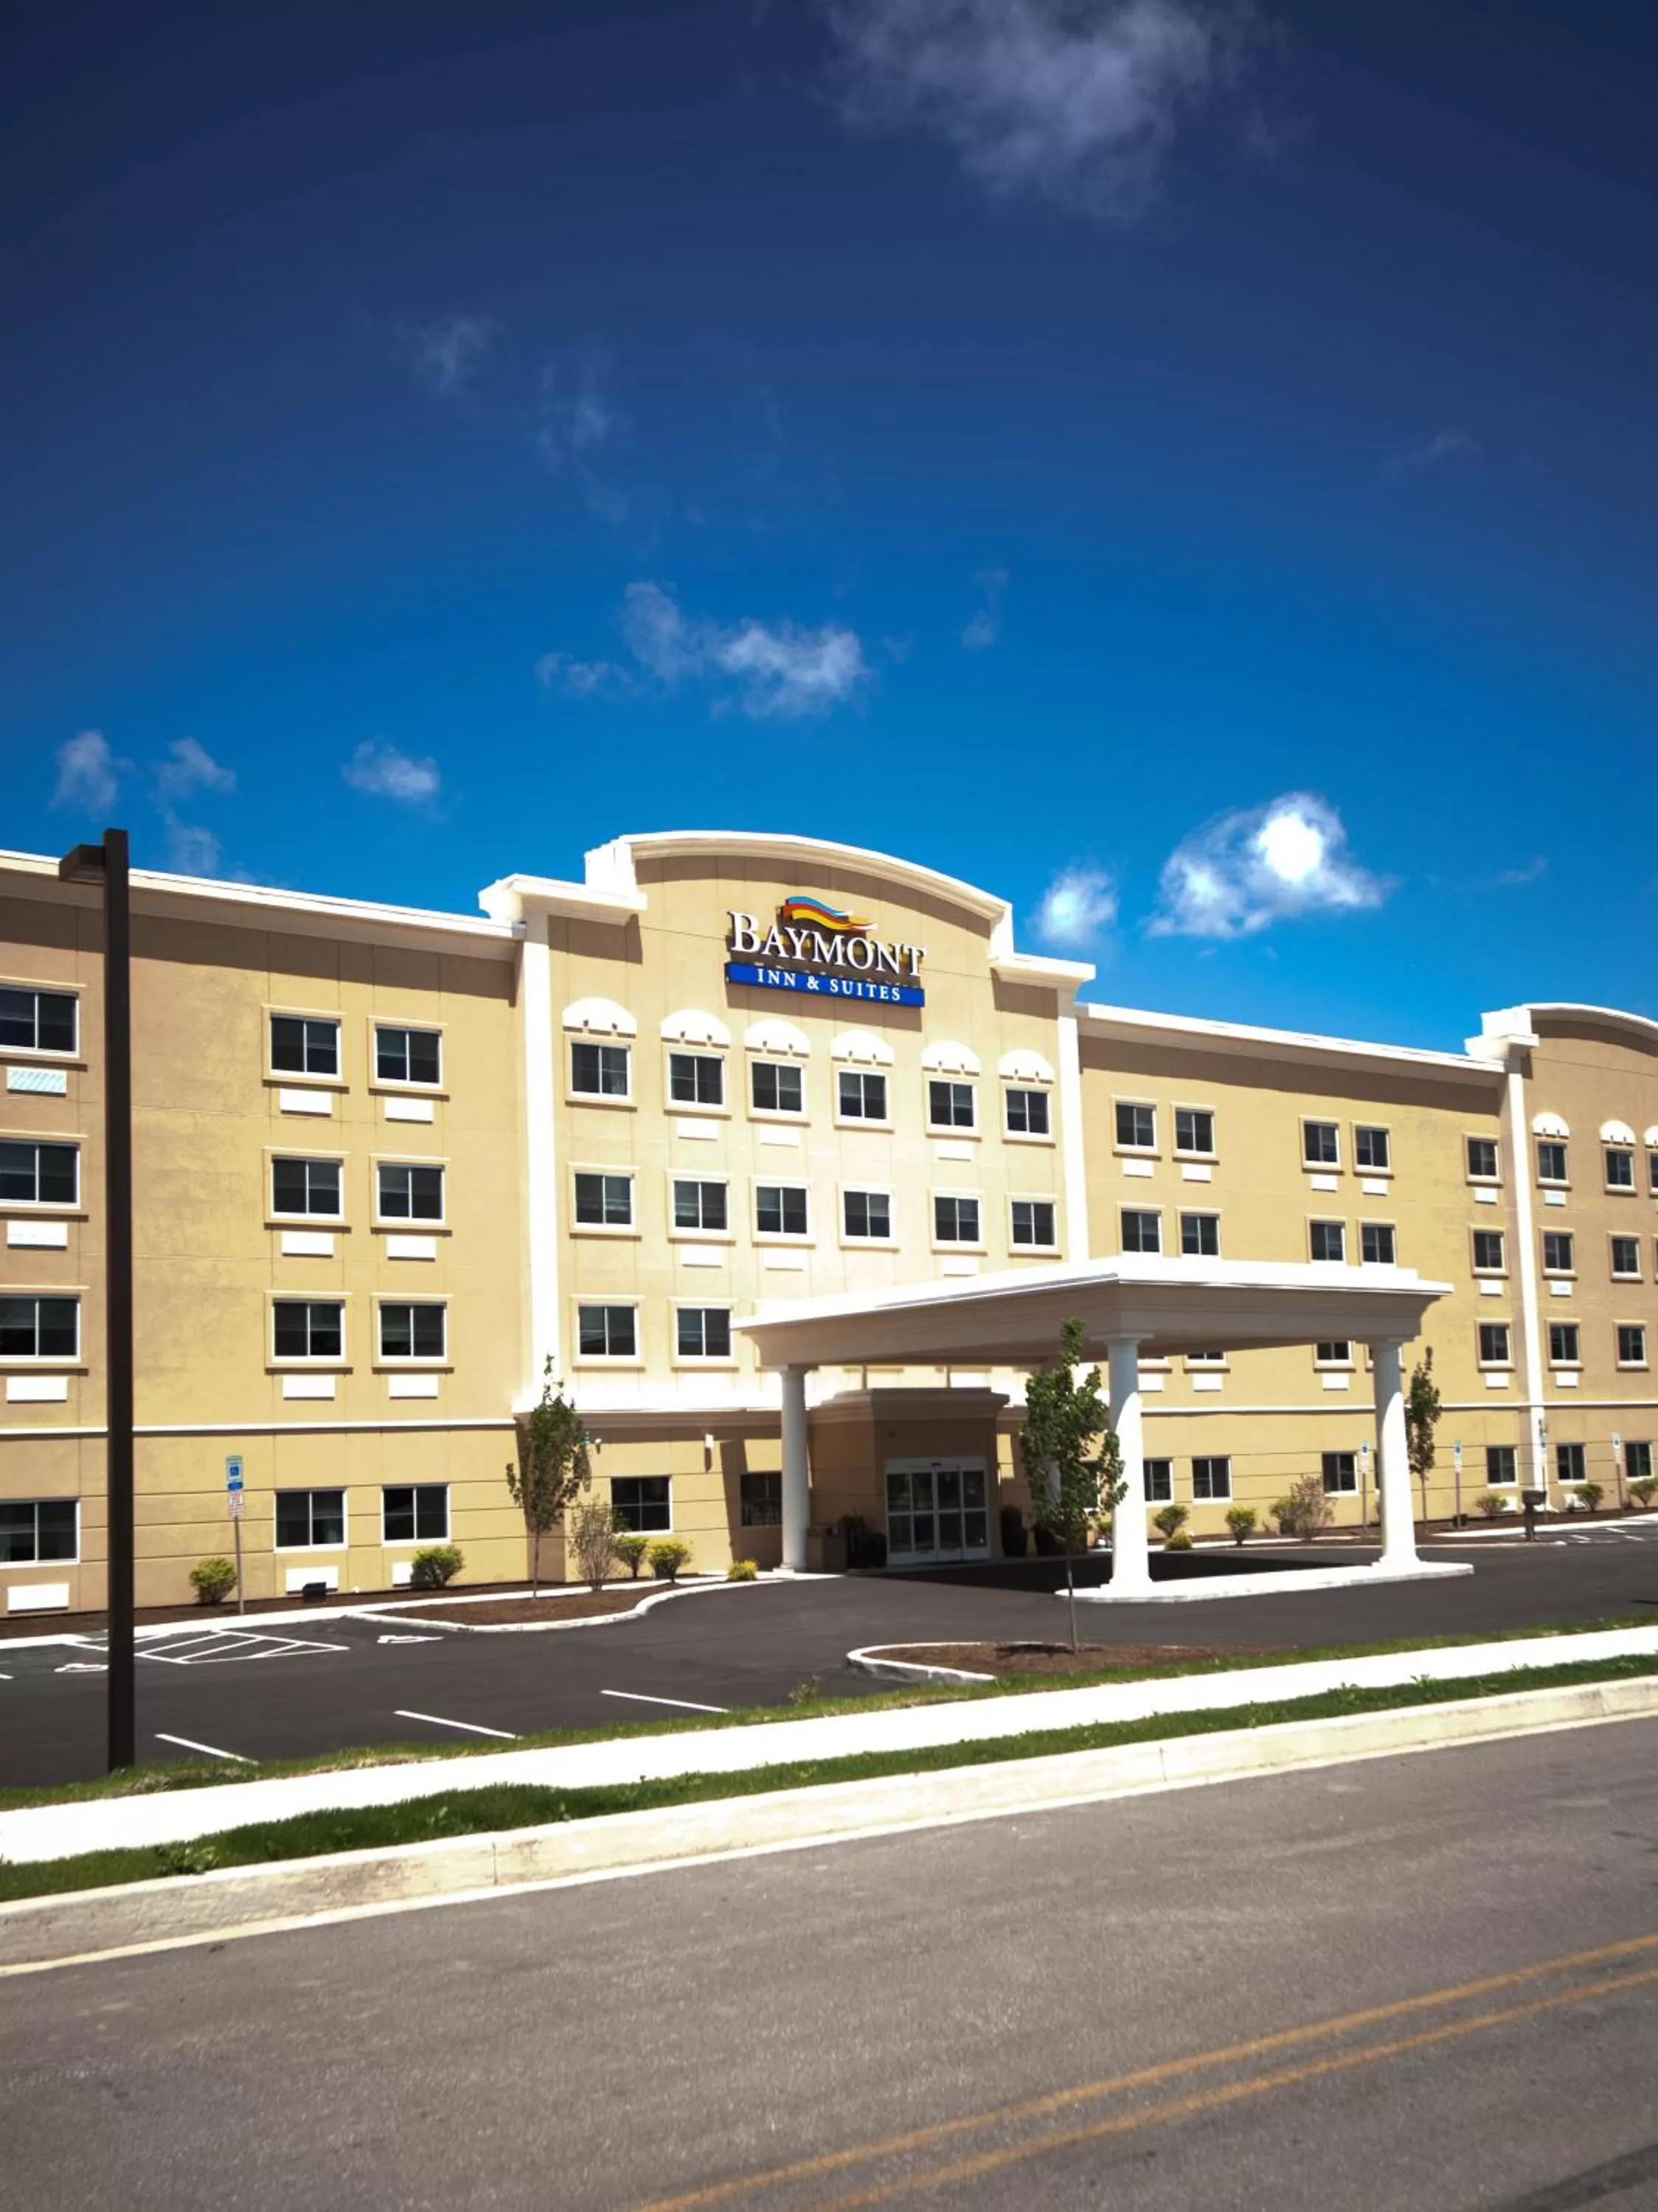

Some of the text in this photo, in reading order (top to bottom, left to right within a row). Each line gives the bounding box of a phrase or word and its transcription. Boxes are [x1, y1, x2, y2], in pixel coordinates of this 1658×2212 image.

[728, 911, 927, 977] BAYMONT
[757, 968, 901, 1001] INN & SUITES
